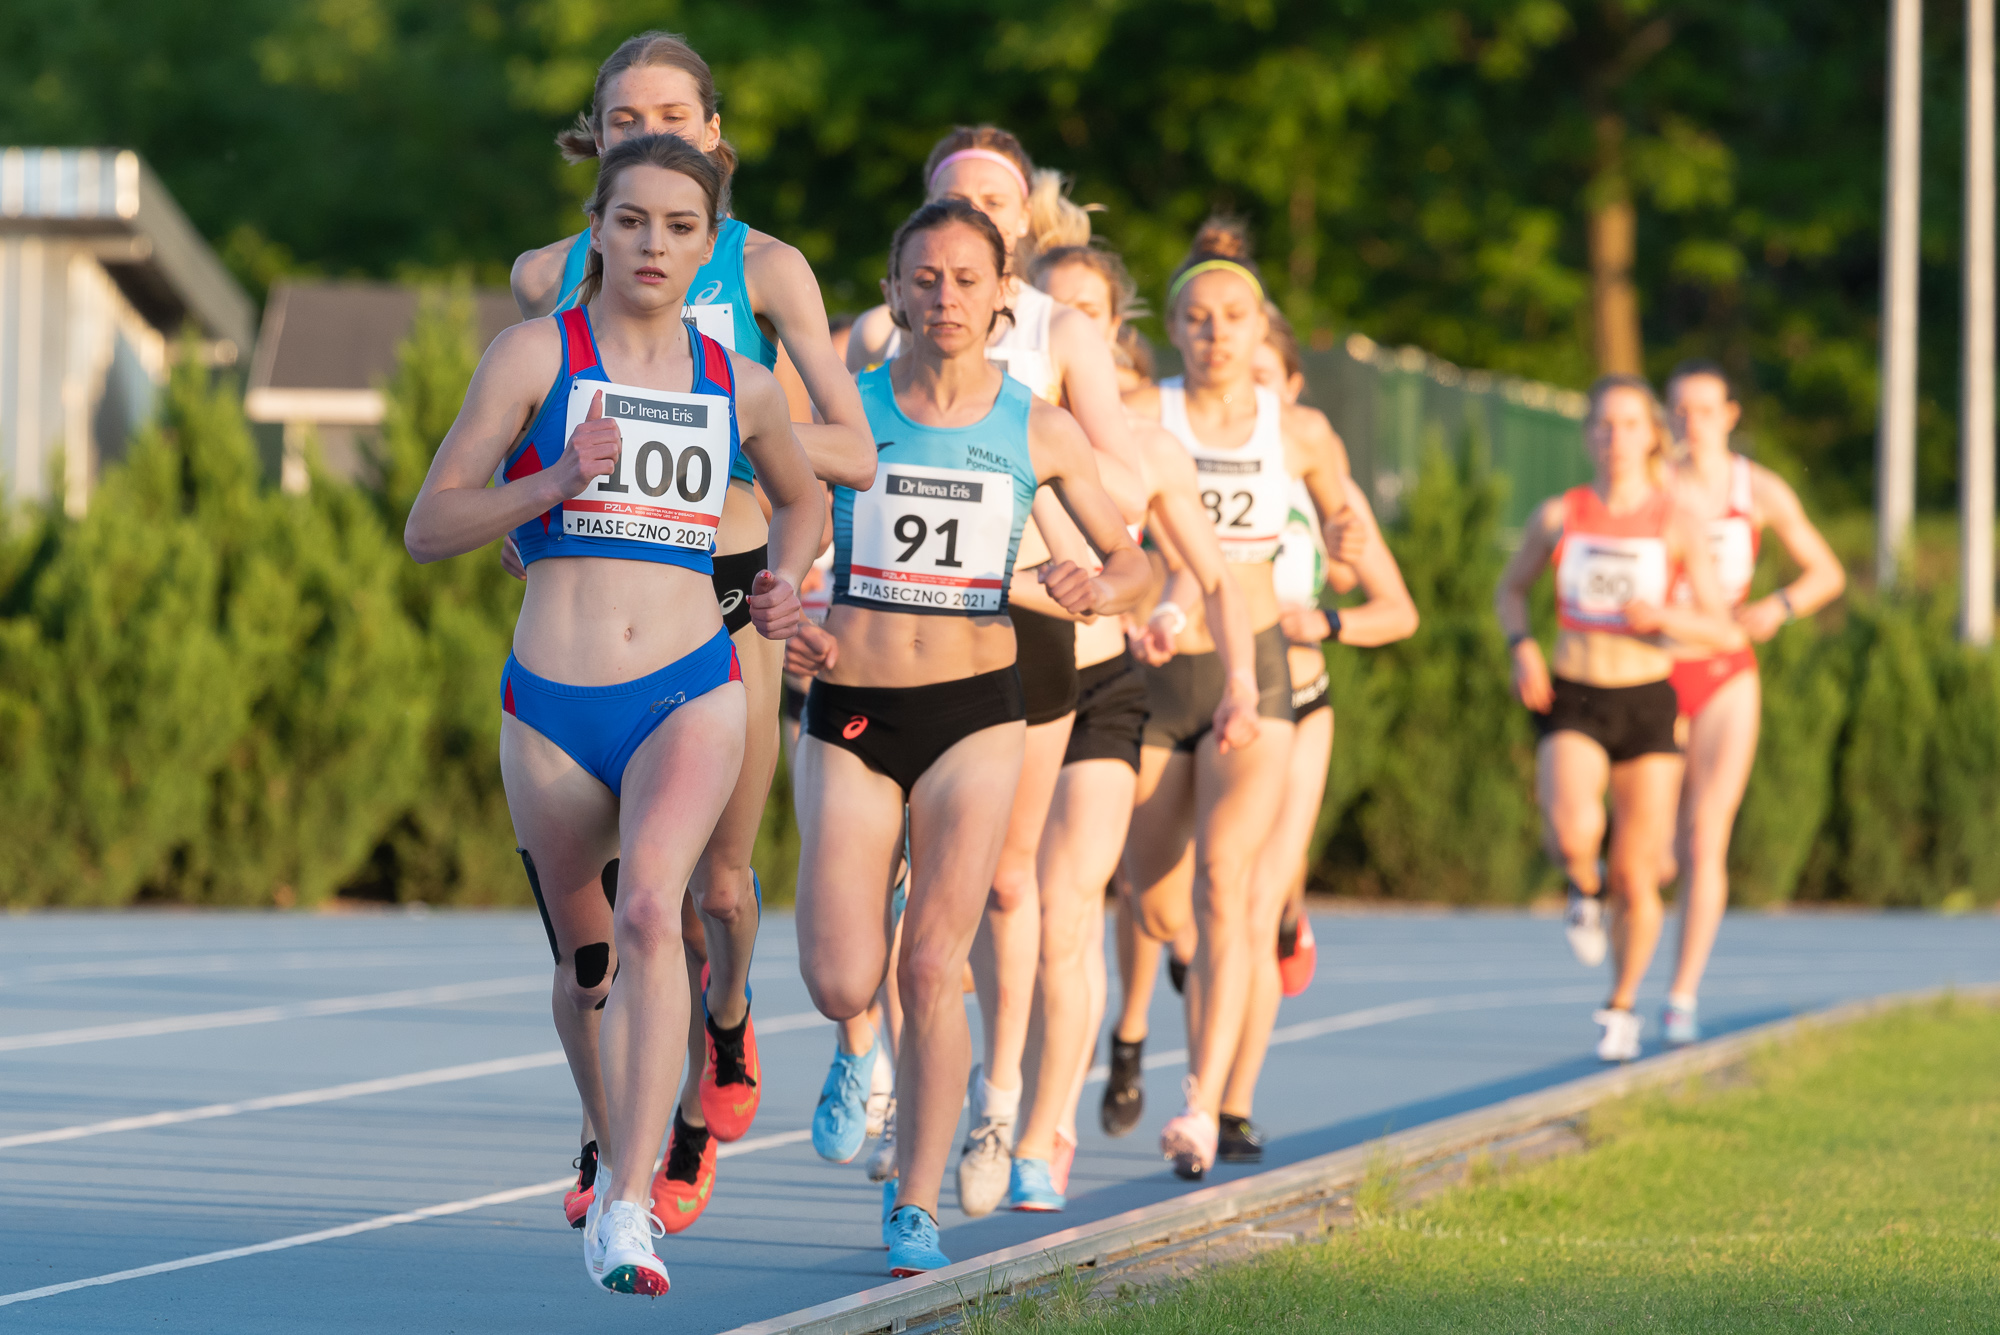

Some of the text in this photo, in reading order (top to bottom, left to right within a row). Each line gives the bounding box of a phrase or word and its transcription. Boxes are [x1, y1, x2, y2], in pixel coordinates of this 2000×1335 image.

[619, 401, 694, 423] Dr Irena Eris
[967, 444, 1009, 468] WMLKS
[597, 437, 712, 503] 100
[898, 478, 970, 499] Dr Irena Eris
[604, 503, 633, 513] PZLA
[1201, 489, 1254, 527] 82
[576, 518, 712, 548] PIASECZNO 2021
[893, 514, 963, 568] 91
[881, 571, 908, 581] PZLA
[860, 581, 985, 608] PIASECZNO 2021
